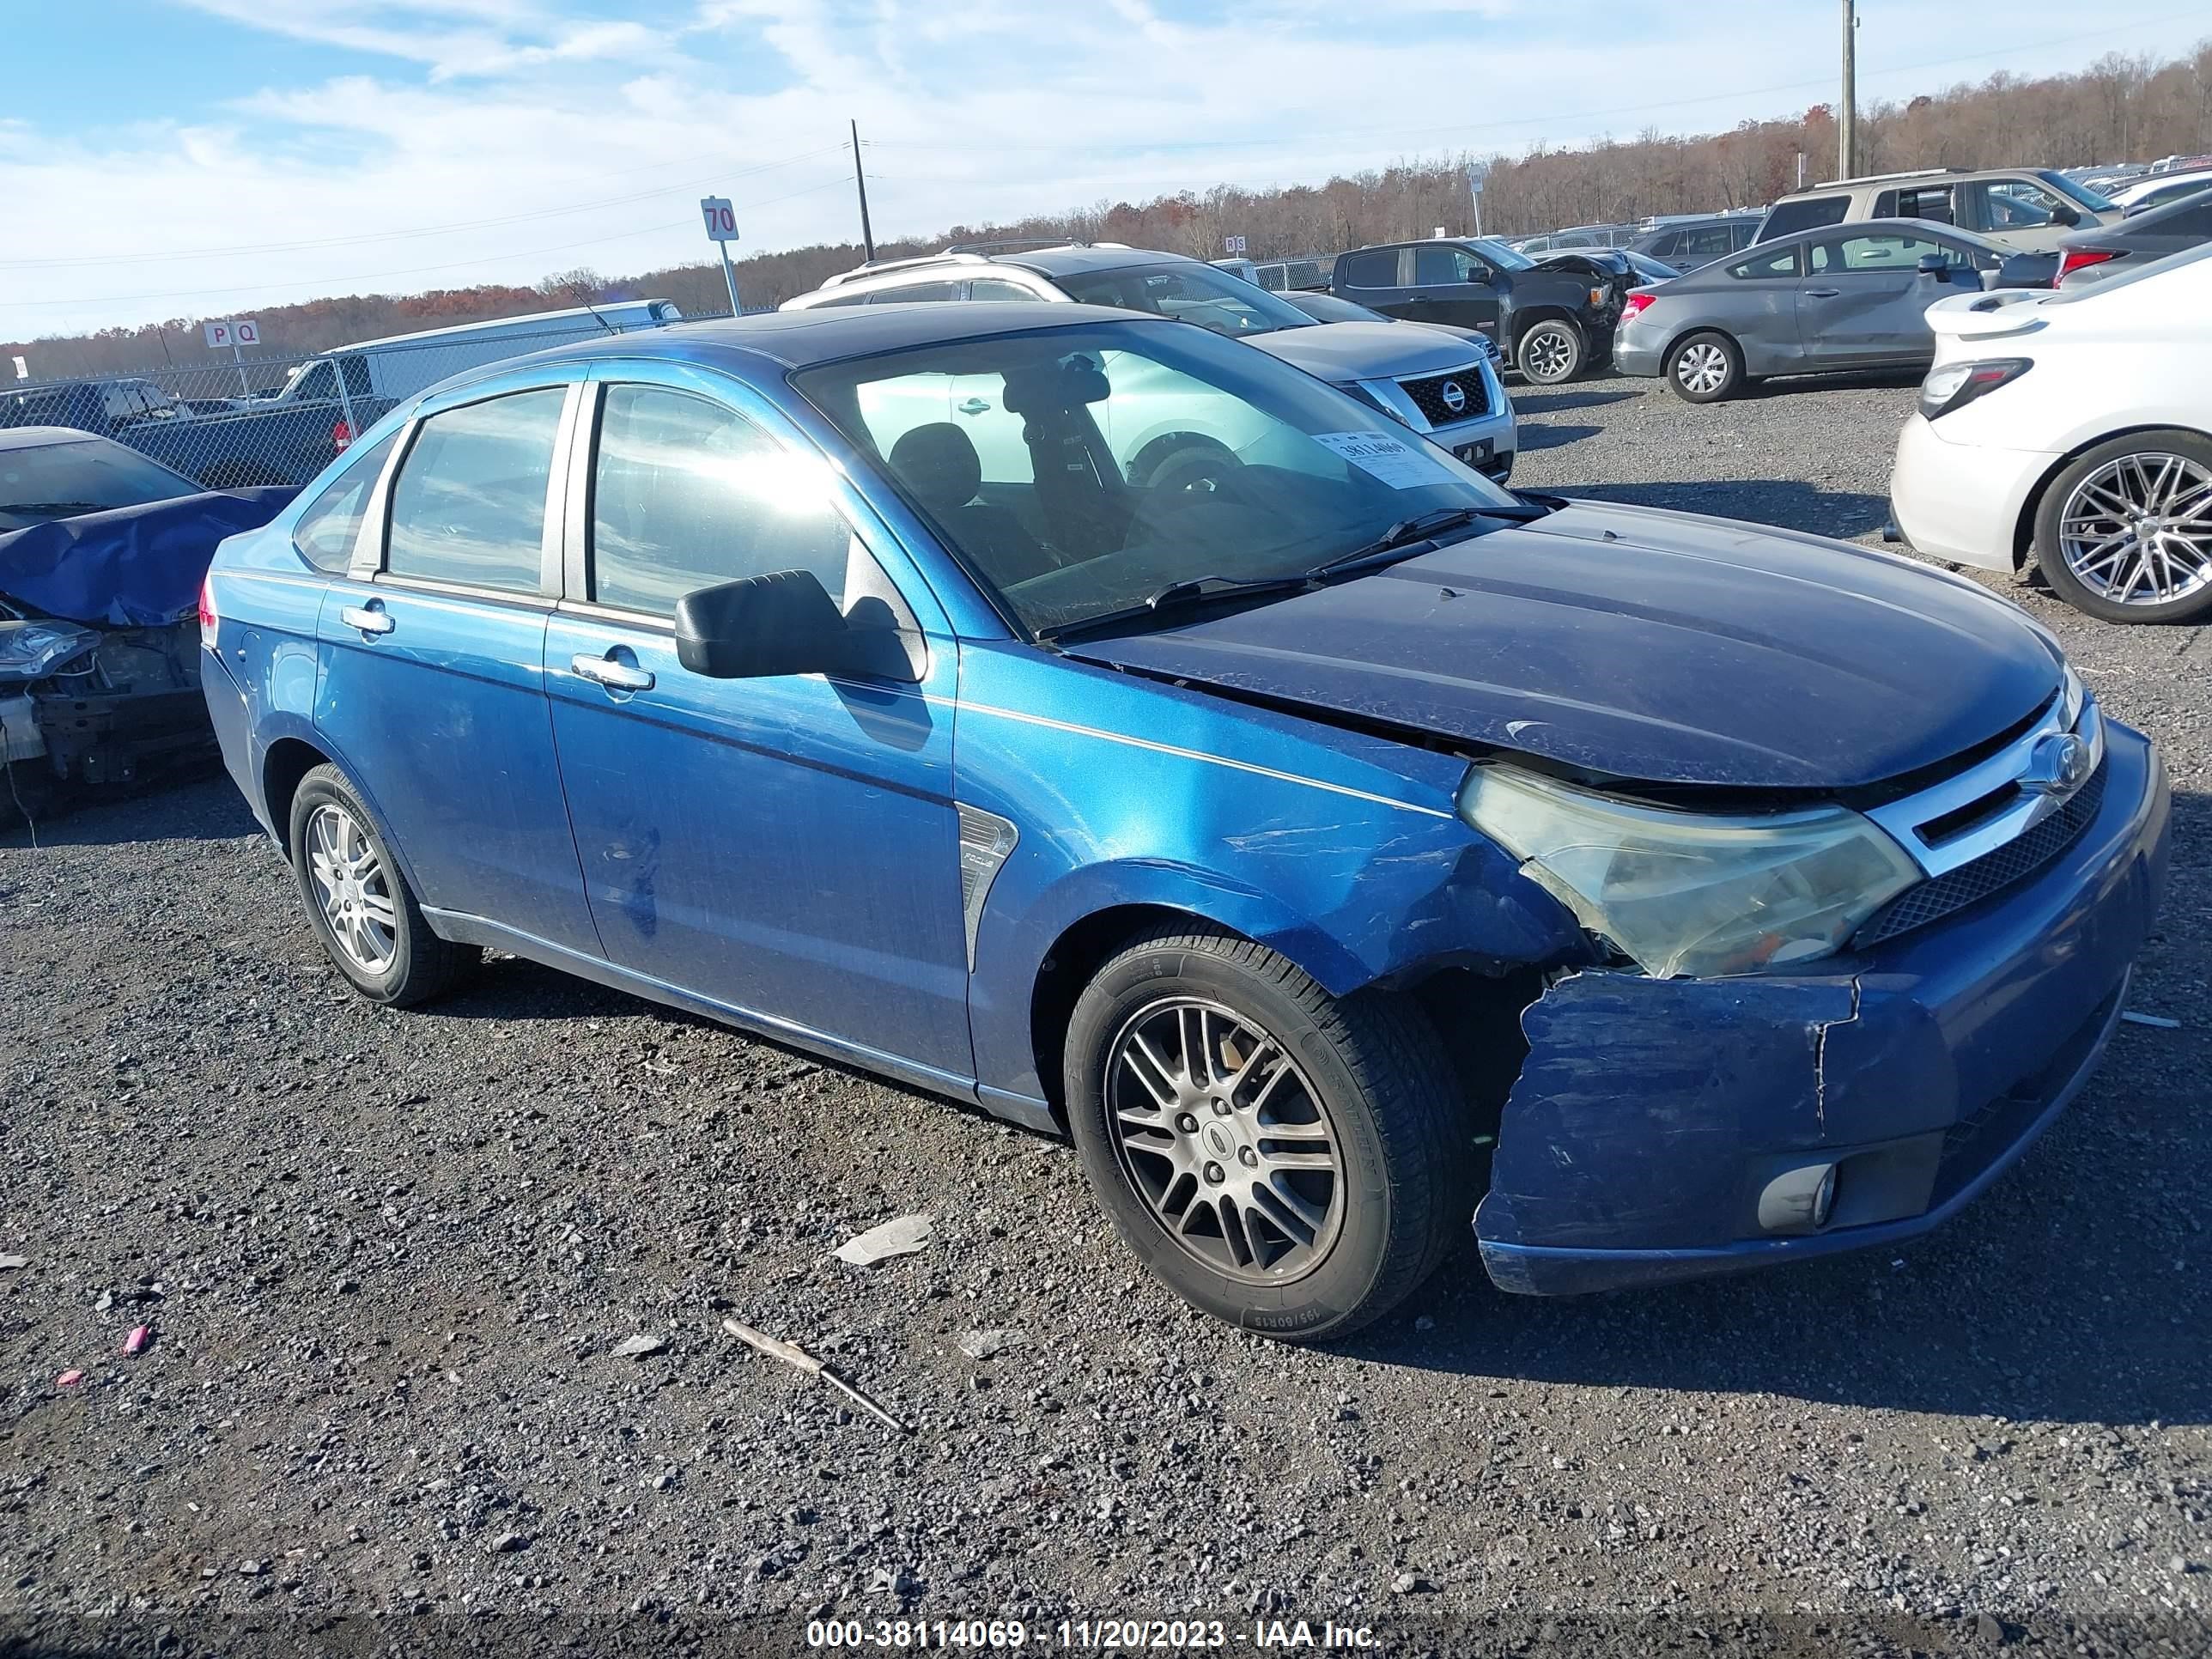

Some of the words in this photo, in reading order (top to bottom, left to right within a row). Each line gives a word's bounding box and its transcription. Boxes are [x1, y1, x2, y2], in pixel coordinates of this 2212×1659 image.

[704, 208, 734, 232] 70
[1228, 240, 1234, 250] R
[1238, 239, 1244, 249] S
[214, 327, 226, 343] P
[239, 325, 256, 342] Q
[963, 852, 994, 867] FOCUS
[1255, 1308, 1322, 1328] 195/60R15
